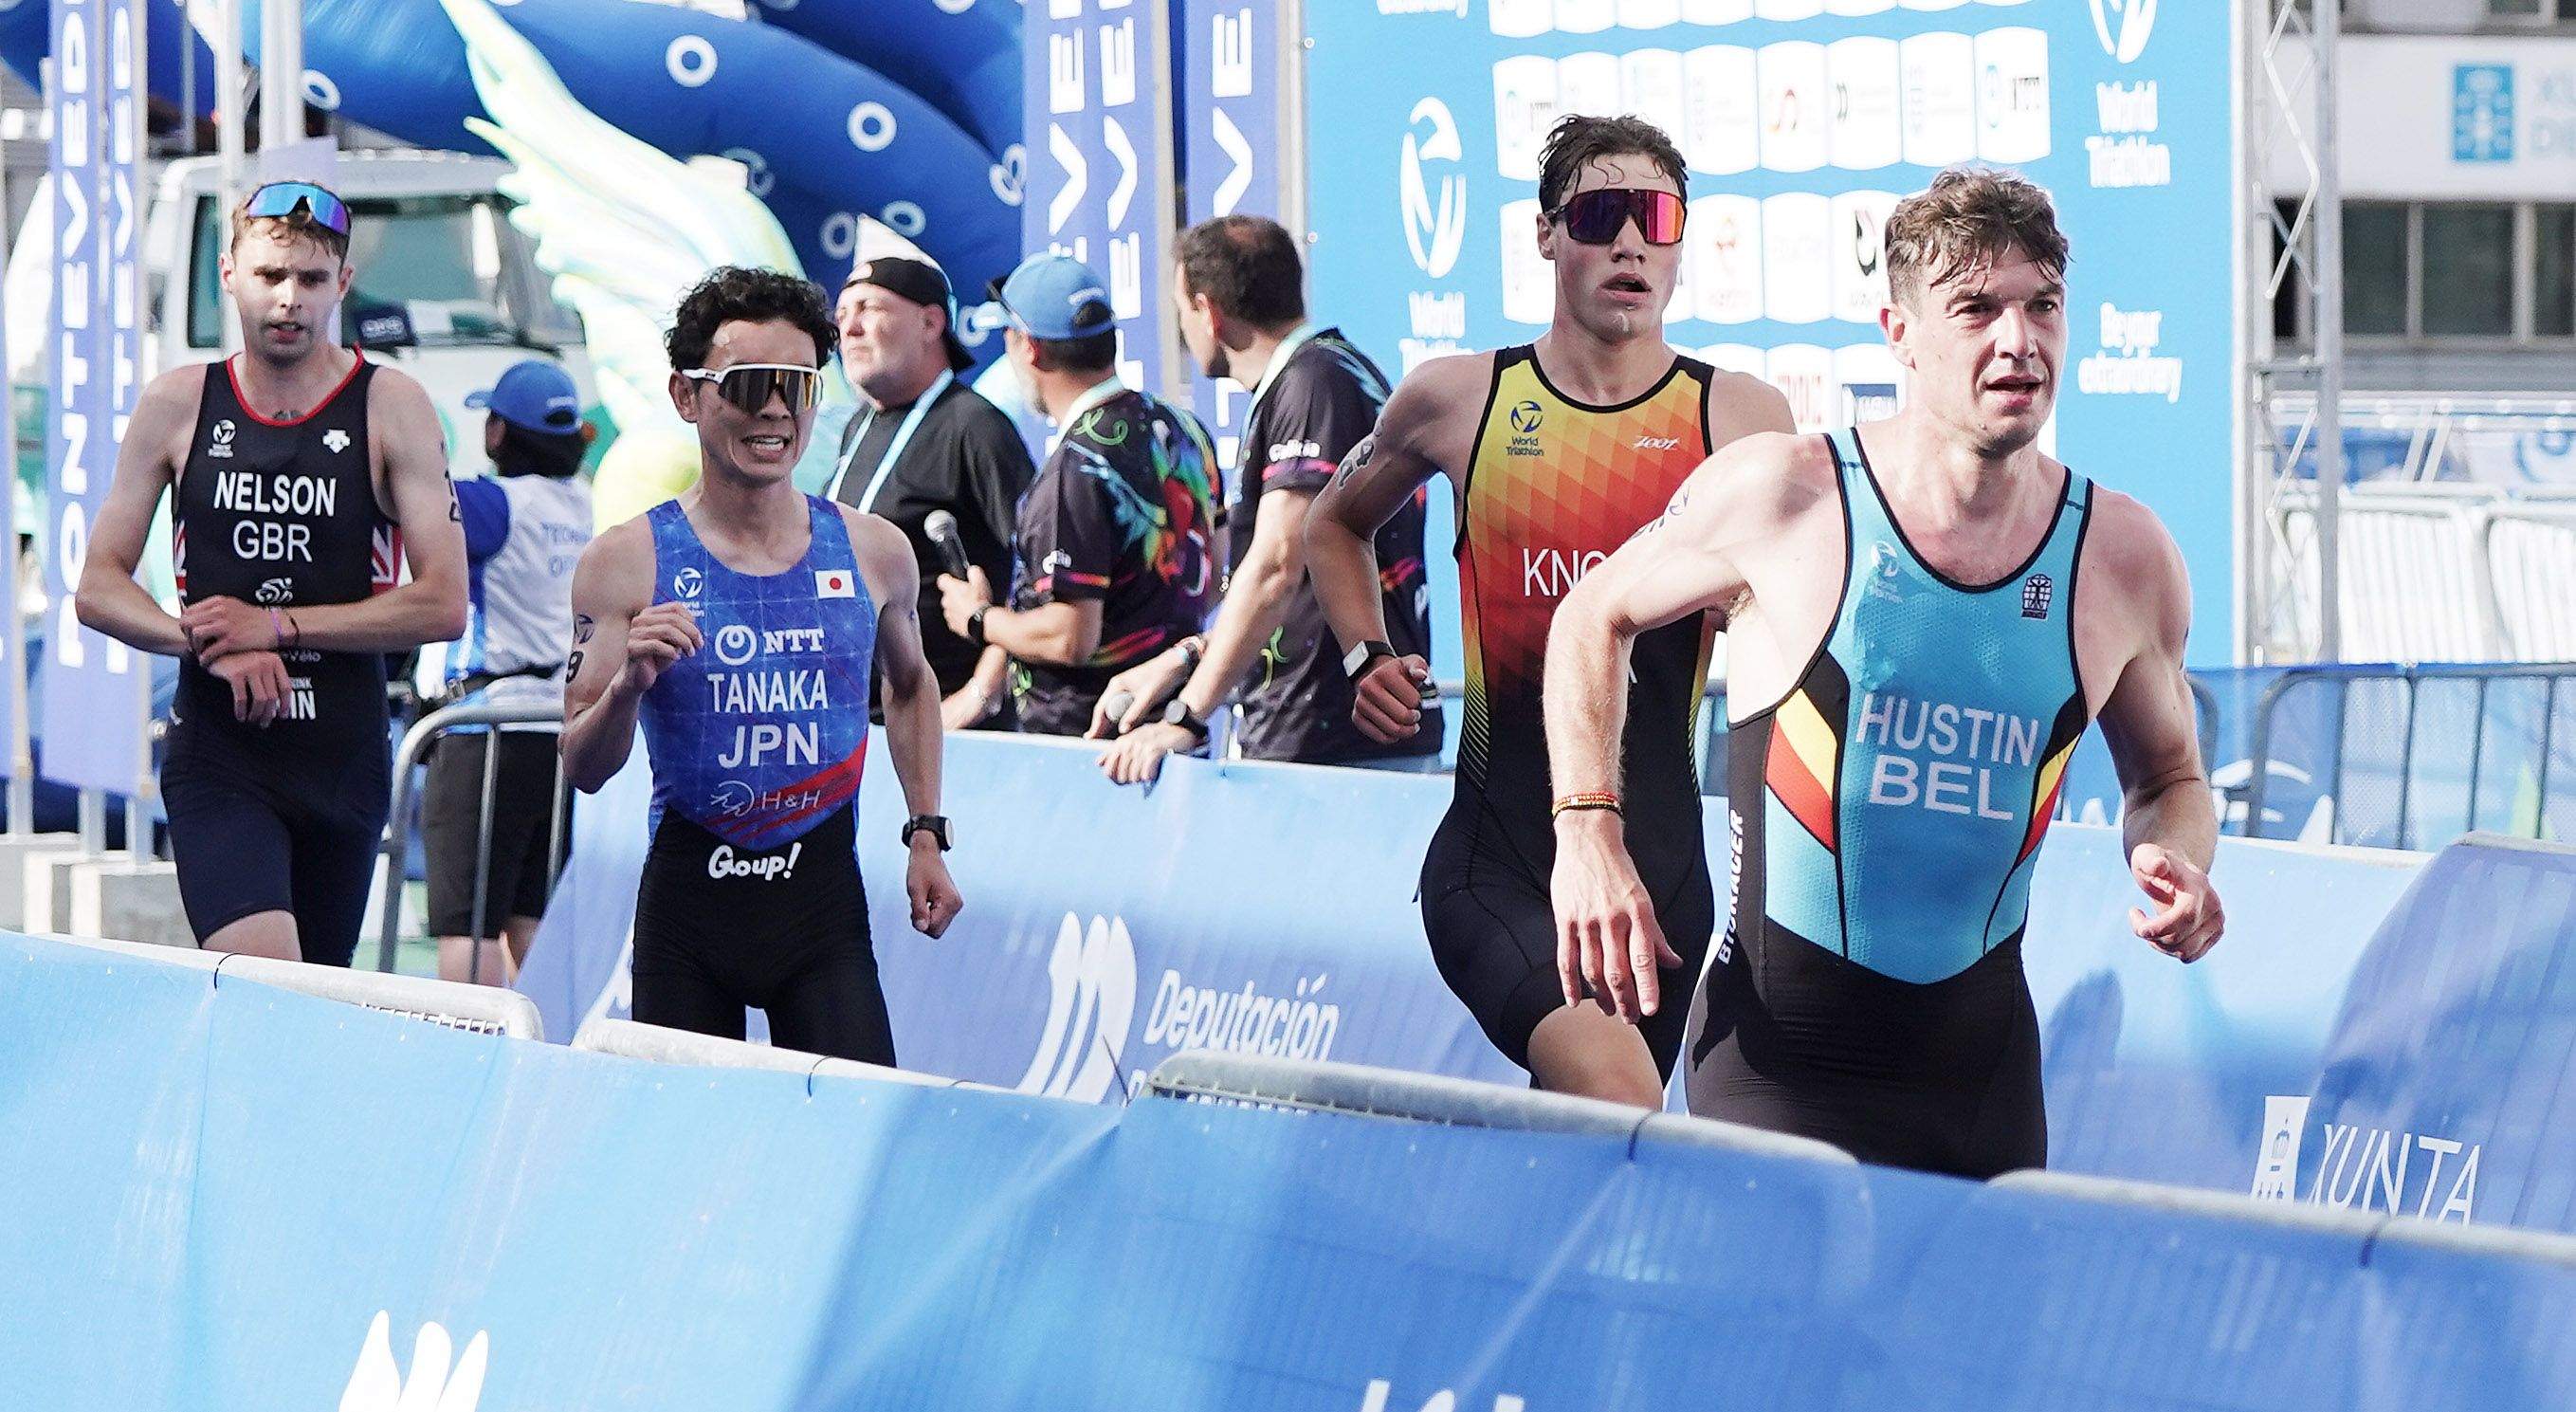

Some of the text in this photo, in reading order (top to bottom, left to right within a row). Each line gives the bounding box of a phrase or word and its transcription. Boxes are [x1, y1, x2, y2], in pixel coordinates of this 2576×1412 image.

[58, 0, 89, 669] PONTEVED
[213, 470, 337, 517] NELSON
[232, 520, 313, 562] GBR
[763, 628, 825, 653] NTT
[707, 669, 829, 713] TANAKA
[718, 722, 818, 768] JPN
[1854, 690, 2038, 767] HUSTIN
[1870, 753, 2015, 821] BEL
[1142, 969, 1340, 1062] Deputación
[2307, 1123, 2480, 1226] XUNTA
